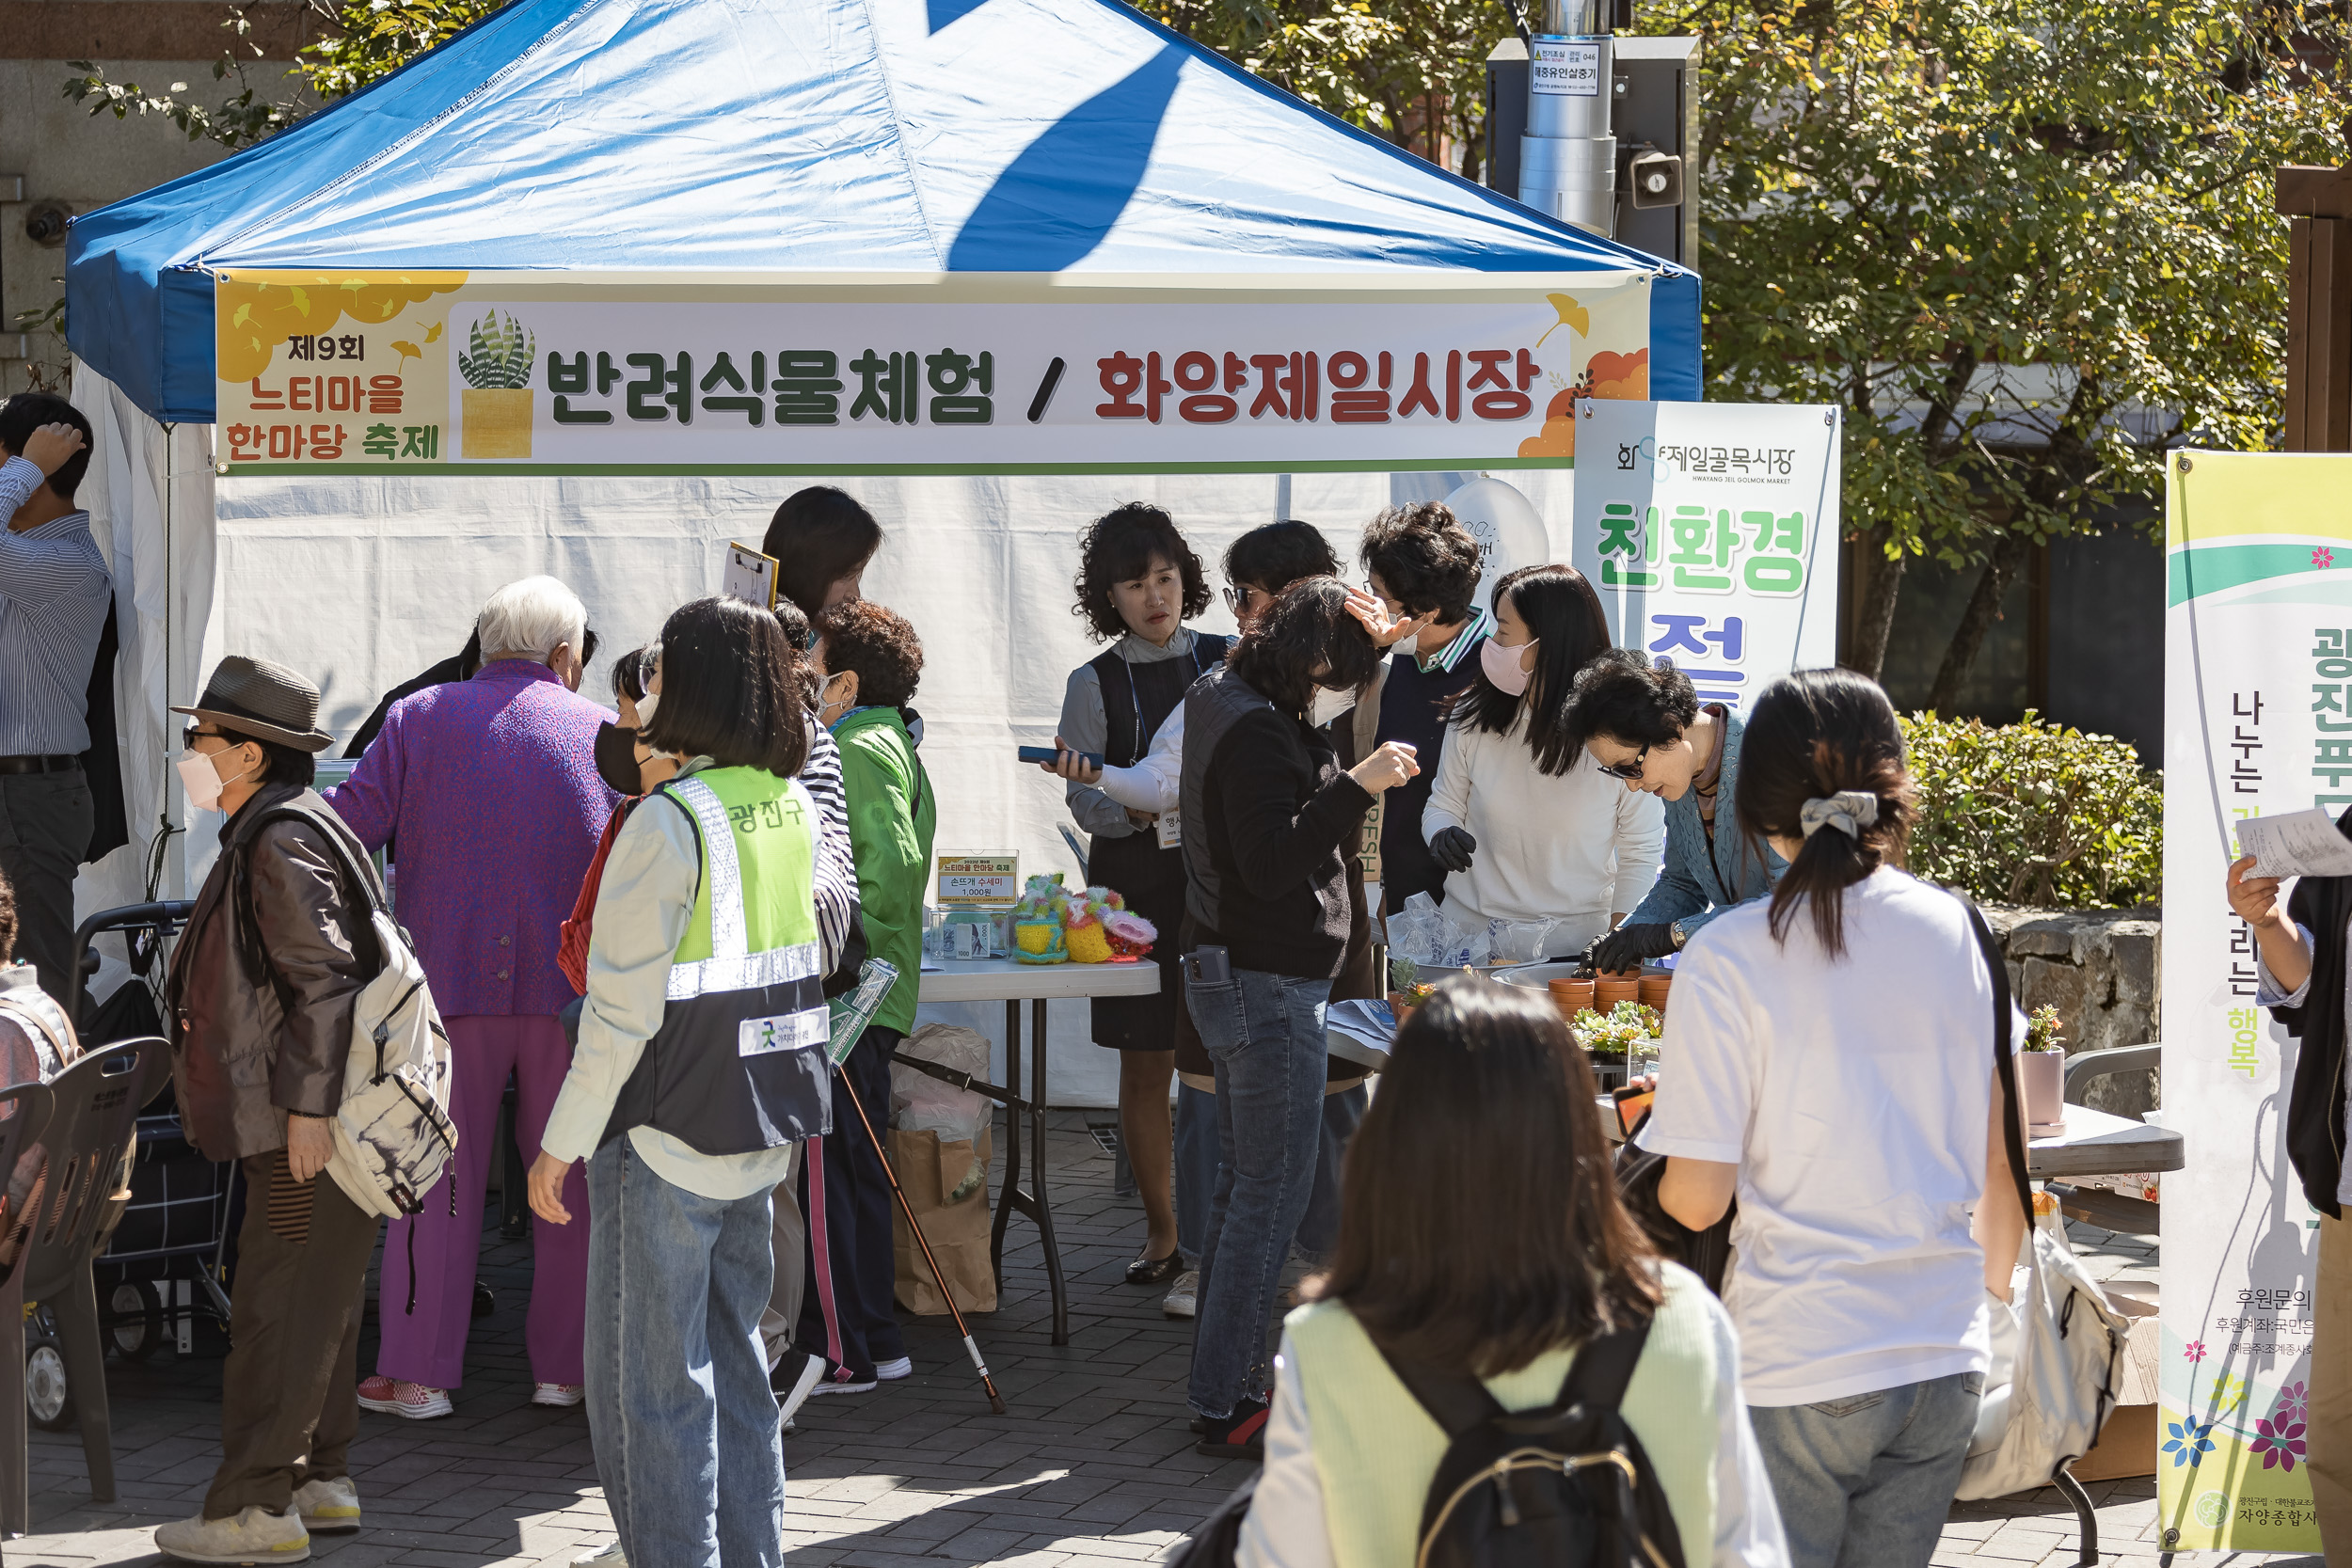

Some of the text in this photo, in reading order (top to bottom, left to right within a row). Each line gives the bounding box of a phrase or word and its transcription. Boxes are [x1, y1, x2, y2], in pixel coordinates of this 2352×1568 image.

[288, 335, 364, 361] 제9회
[249, 375, 405, 414] 느티마을
[547, 348, 1543, 426] 반려식물체험 / 화양제일시장
[227, 422, 439, 461] 한마당 축제
[1597, 503, 1804, 593] 친환경
[2230, 690, 2265, 794] 나누는
[728, 799, 804, 833] 광진구
[950, 878, 1003, 887] 손뜨개 수세미
[961, 888, 992, 897] 1,000원
[2228, 911, 2259, 996] 리는
[2228, 1007, 2260, 1078] 행복
[2235, 1288, 2311, 1311] 후원문의
[2239, 1497, 2268, 1506] 광진구립
